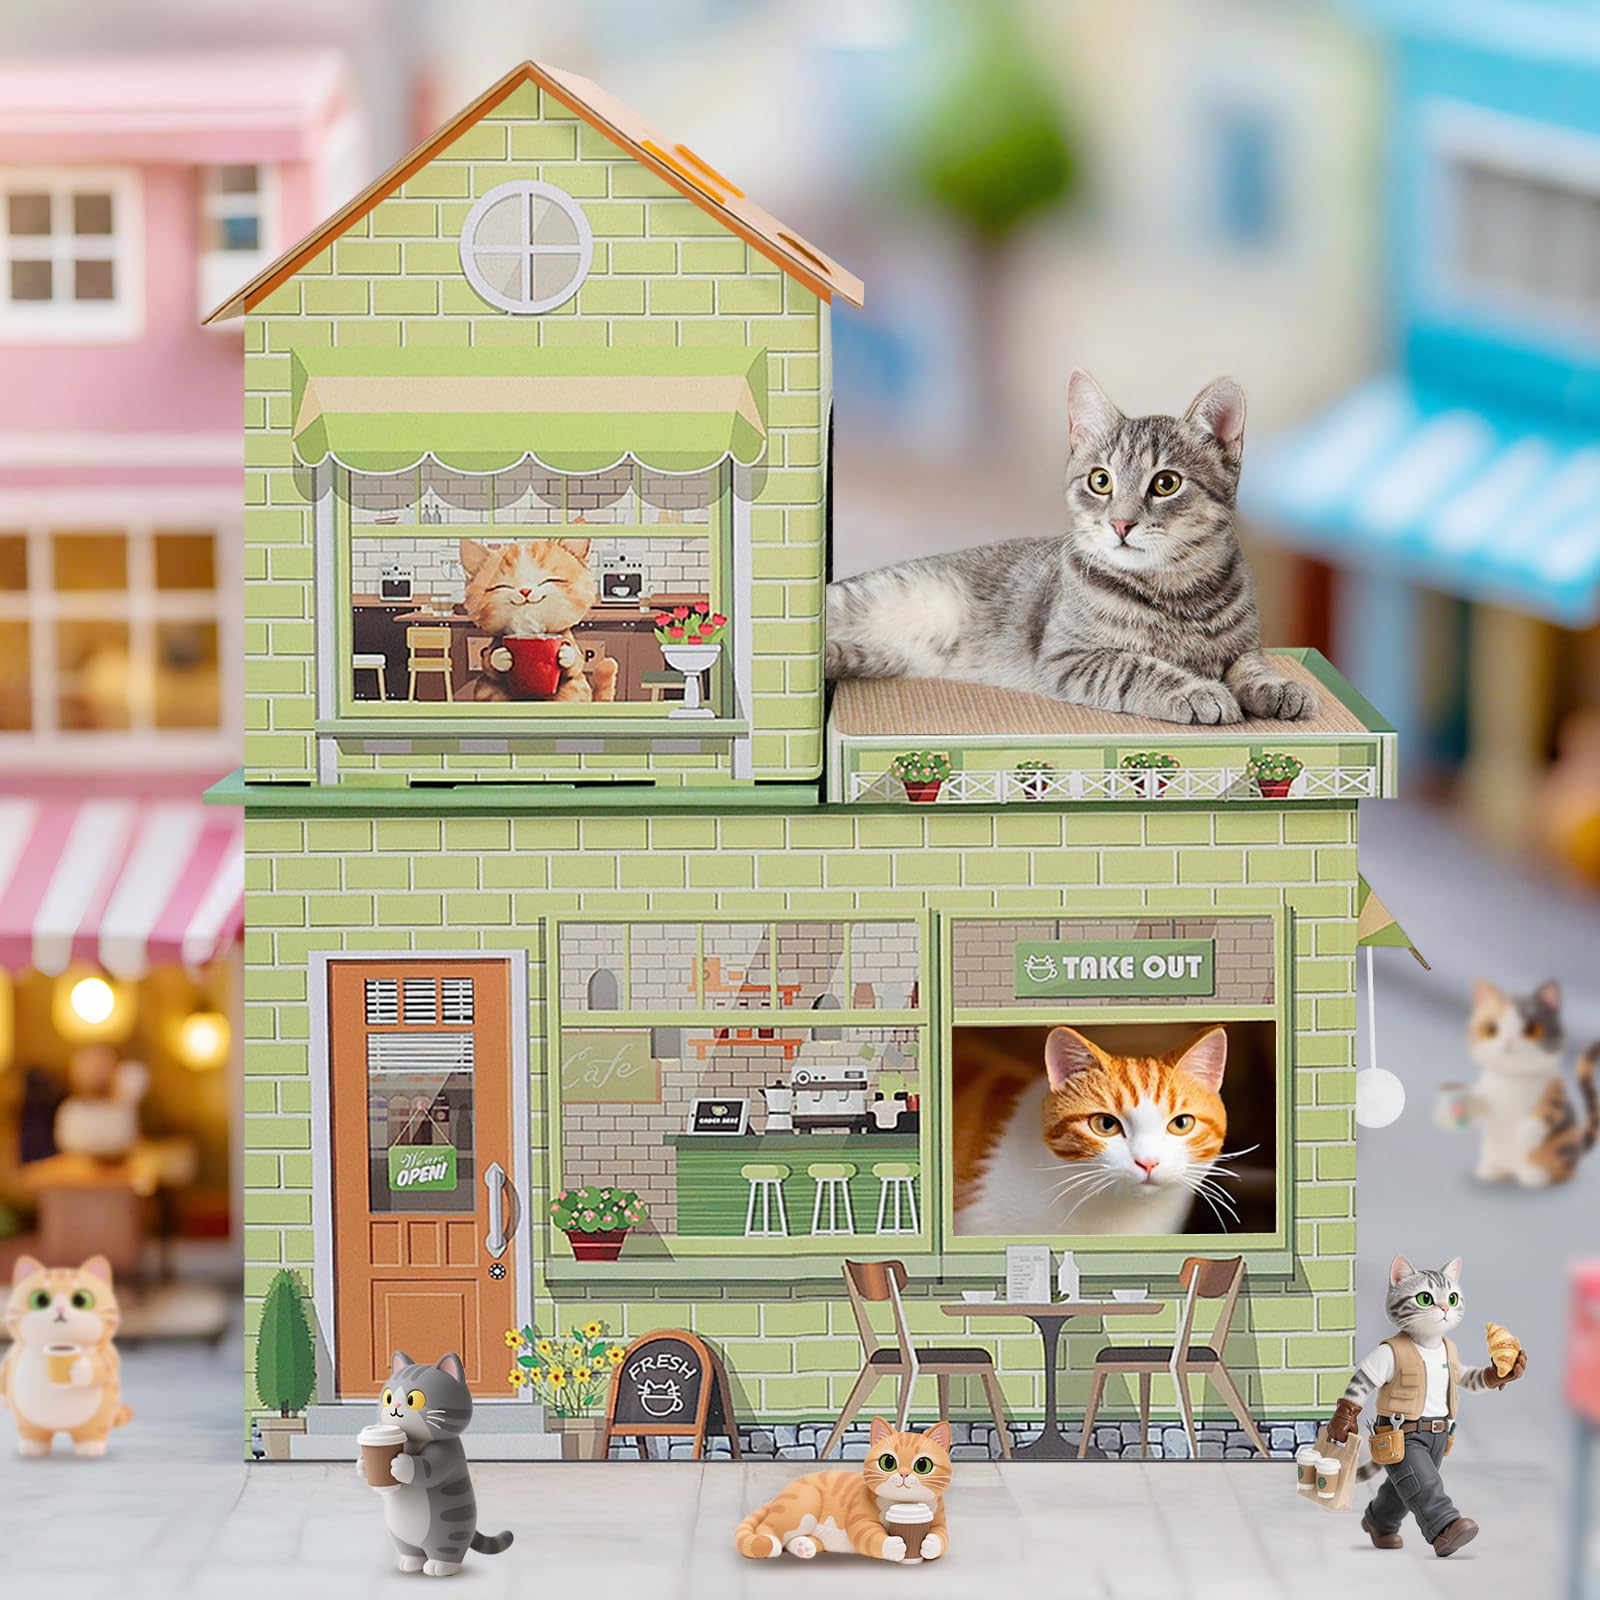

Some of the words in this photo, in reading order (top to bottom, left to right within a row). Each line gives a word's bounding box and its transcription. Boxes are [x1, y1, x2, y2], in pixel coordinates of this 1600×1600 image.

[1062, 956, 1134, 980] TAKE
[1142, 955, 1203, 979] OUT
[401, 1150, 425, 1169] We
[396, 1161, 449, 1187] OPEN!
[628, 1354, 697, 1381] FRESH
